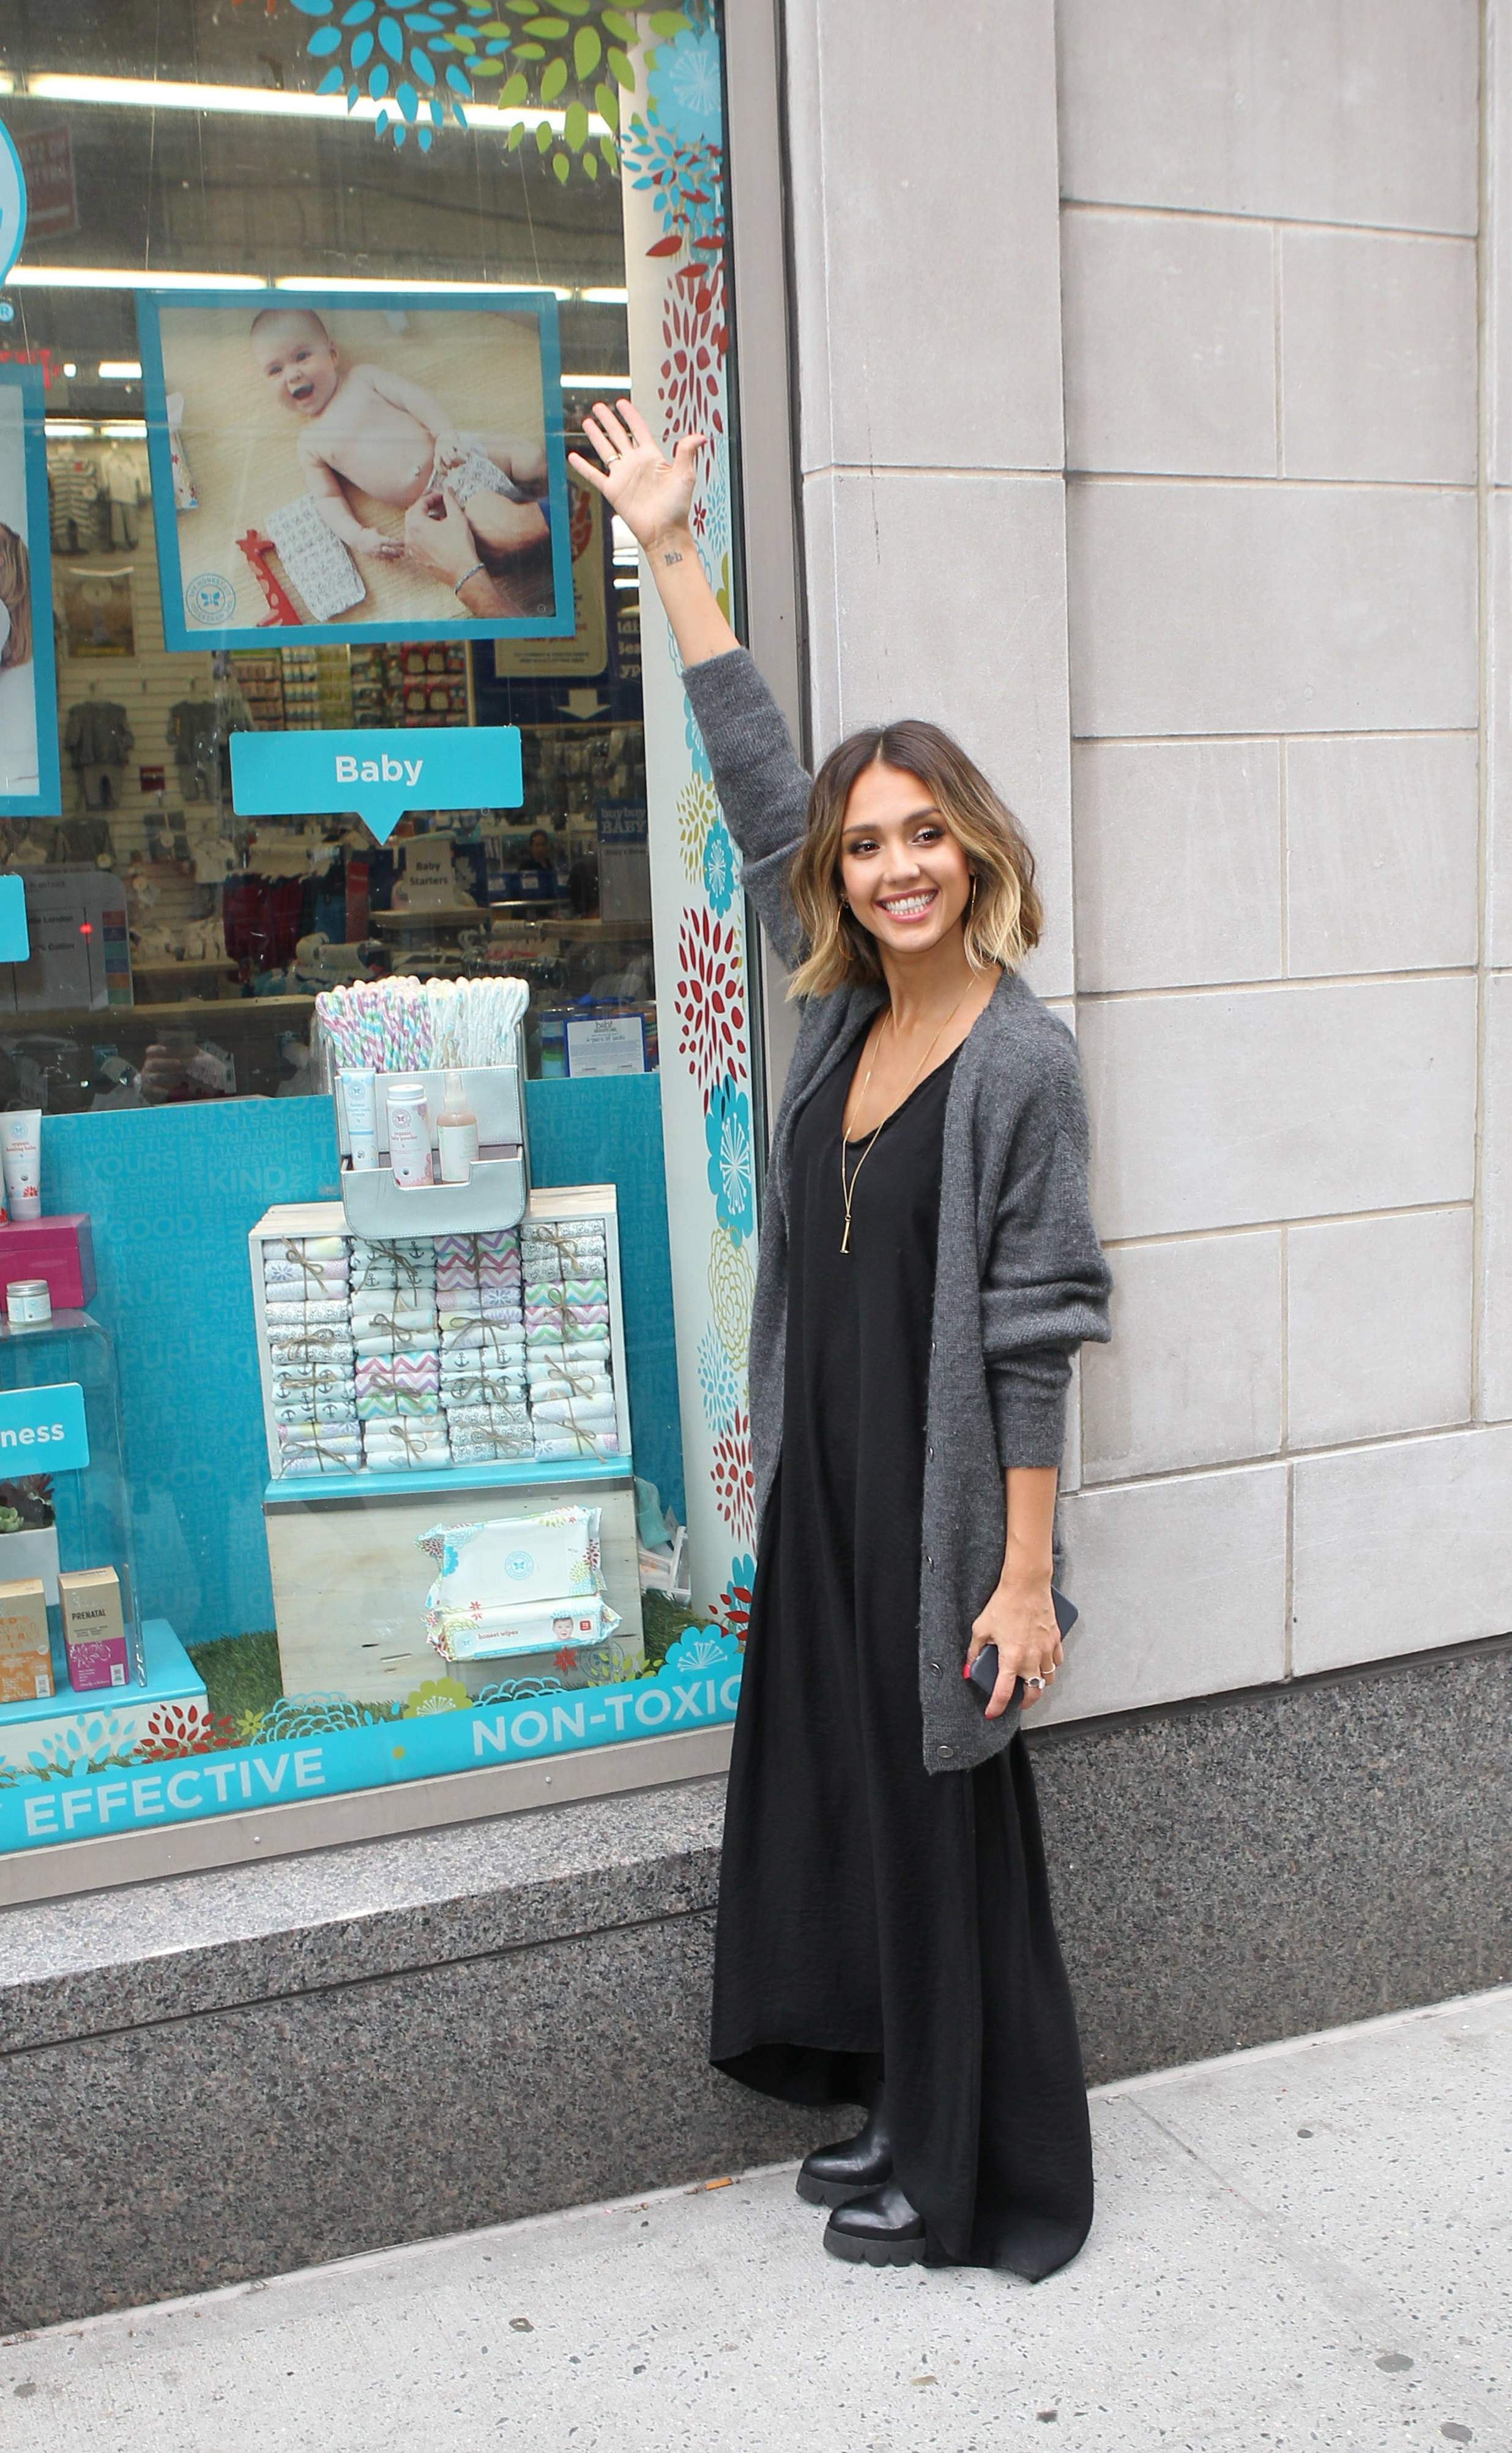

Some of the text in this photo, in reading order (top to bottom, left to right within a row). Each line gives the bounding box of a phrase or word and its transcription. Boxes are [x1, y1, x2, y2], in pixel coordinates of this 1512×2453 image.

[335, 753, 423, 786] Baby
[416, 862, 440, 871] Baby
[409, 877, 448, 886] Starters
[531, 1119, 598, 1140] OURS
[83, 1150, 179, 1178] YOURS
[208, 1166, 286, 1196] KIND
[105, 1212, 197, 1243] GOOD
[98, 1278, 177, 1308] TRUE
[120, 1338, 209, 1371] PURE
[119, 1404, 195, 1432] OURS
[1, 1424, 65, 1448] ness
[72, 1608, 106, 1621] PRENATAL
[478, 1629, 519, 1641] honest wipes
[472, 1674, 742, 1756] NON-TOXIC
[24, 1748, 326, 1836] EFFECTIVE
